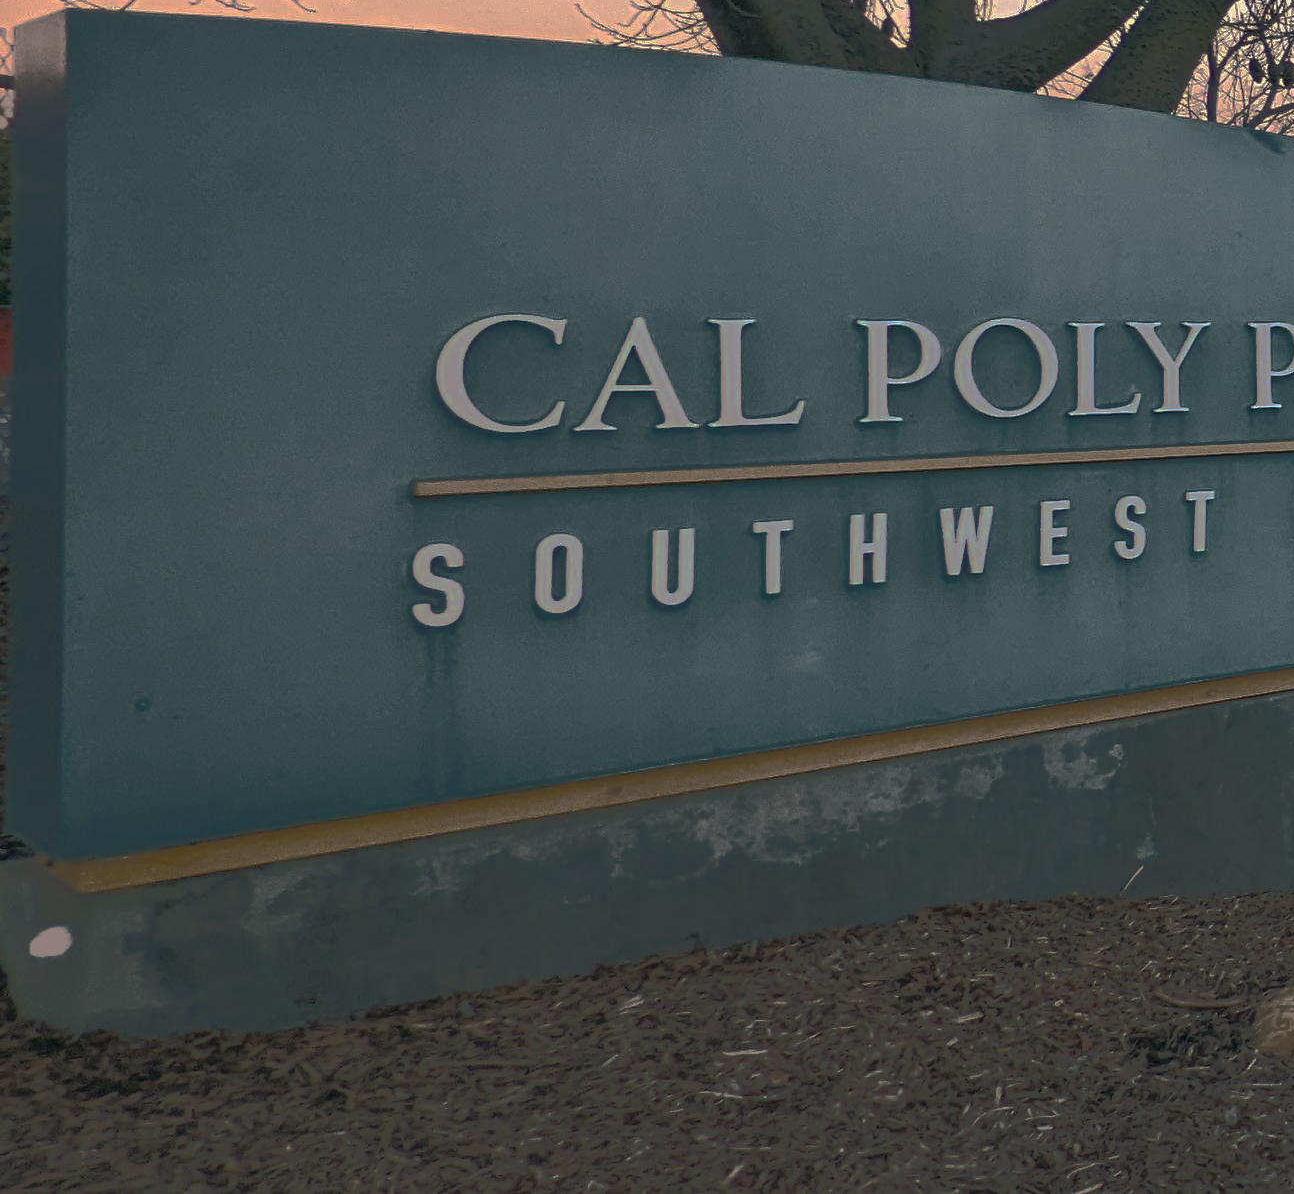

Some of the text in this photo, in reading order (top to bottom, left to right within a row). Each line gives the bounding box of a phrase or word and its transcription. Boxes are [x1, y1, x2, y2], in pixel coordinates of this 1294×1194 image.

[435, 312, 805, 433] CAL
[856, 316, 1212, 423] POLY
[411, 488, 1216, 627] SOUTHWEST
